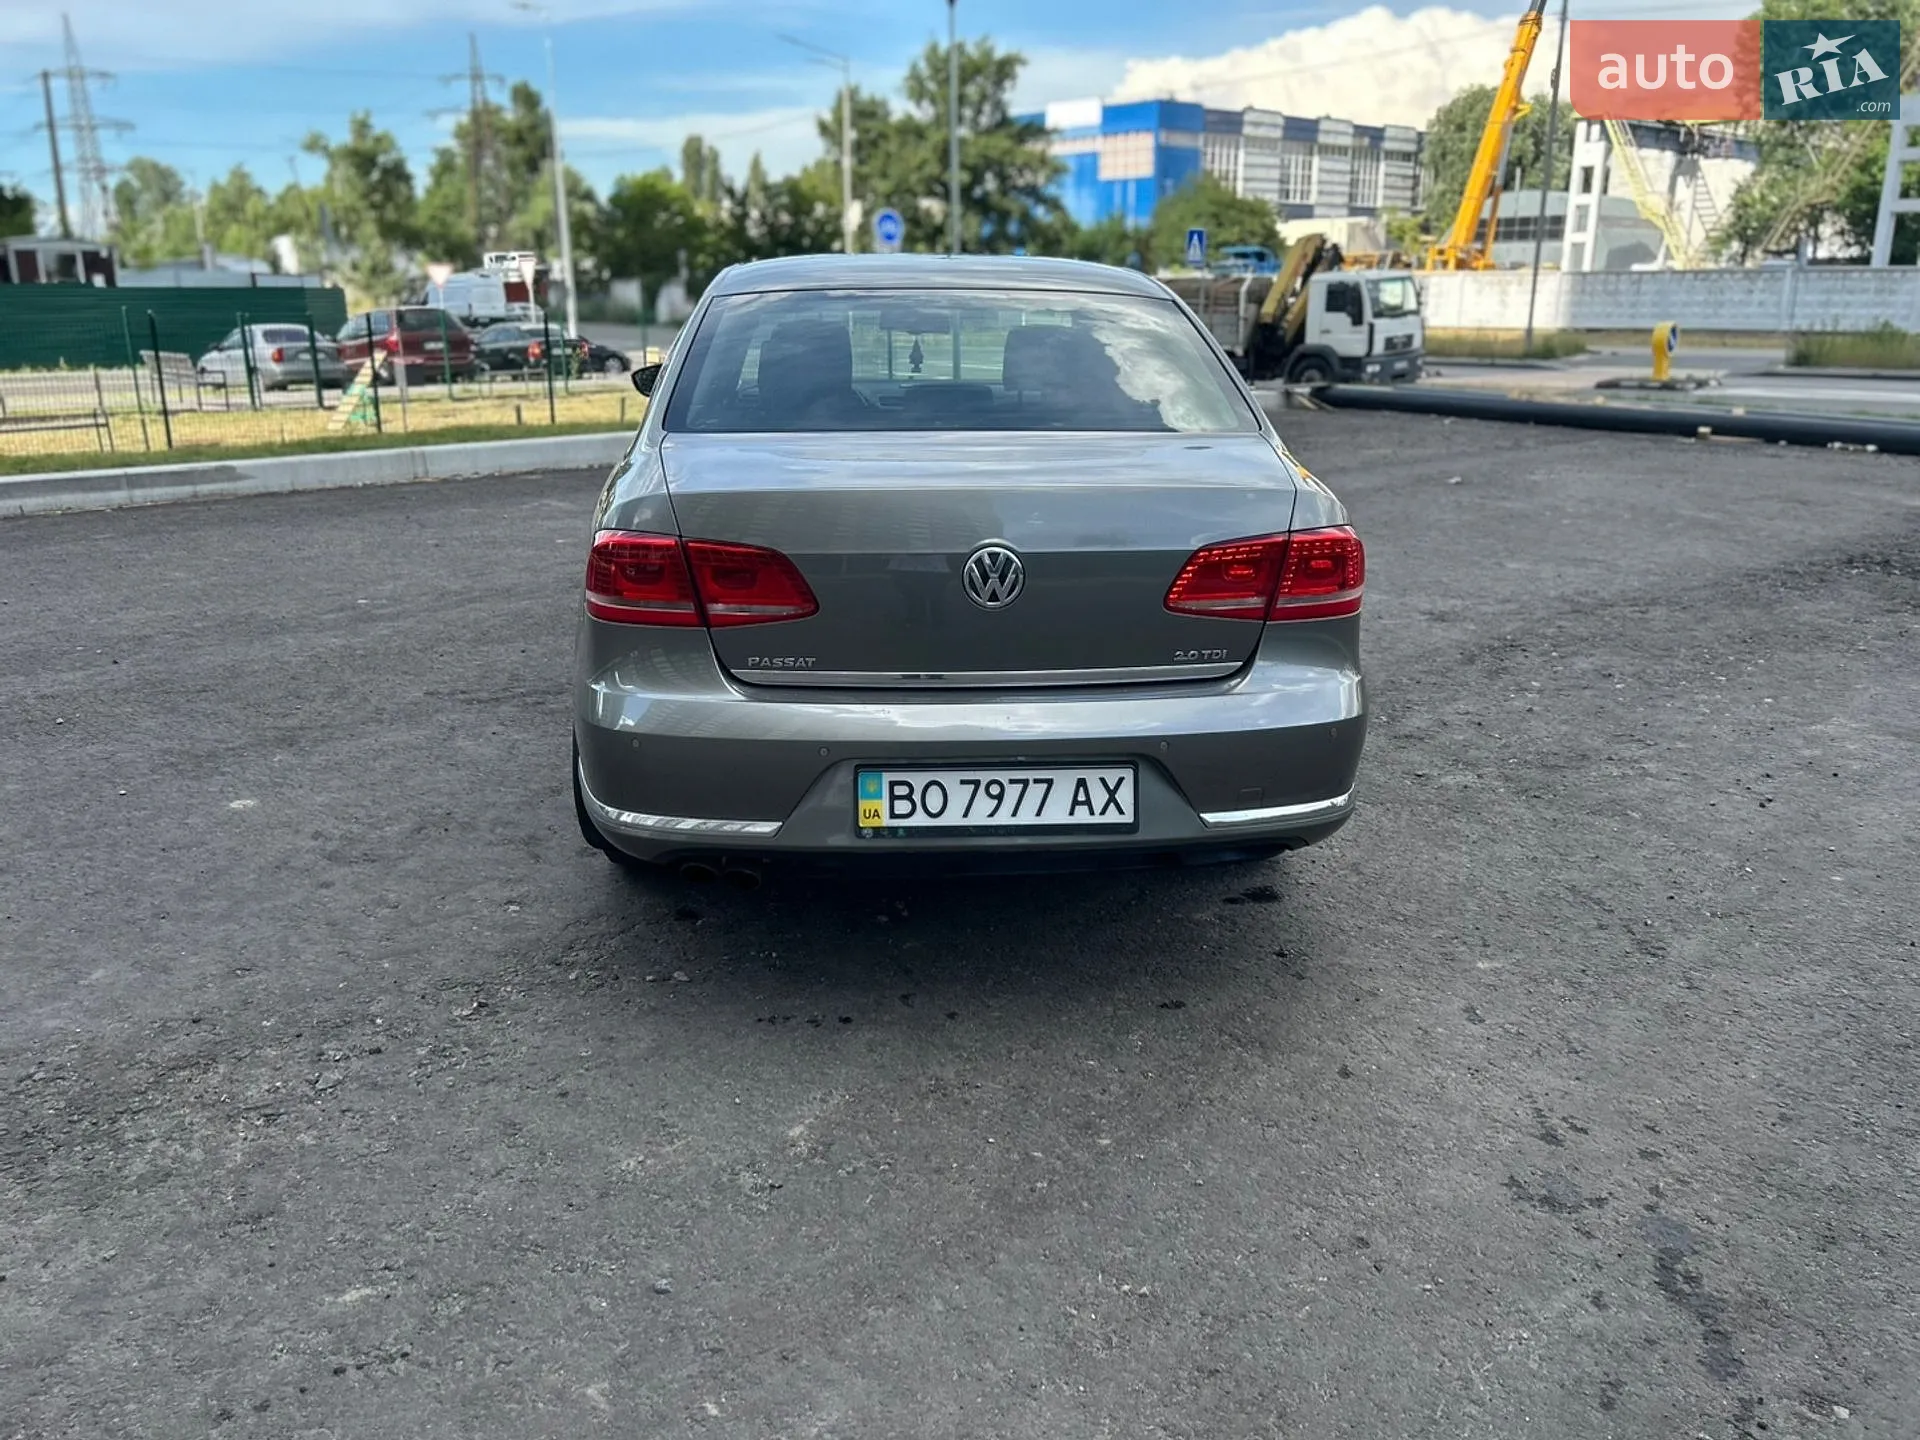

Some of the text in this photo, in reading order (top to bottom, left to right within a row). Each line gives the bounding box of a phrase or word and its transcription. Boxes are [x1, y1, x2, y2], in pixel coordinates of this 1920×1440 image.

[1201, 649, 1228, 660] TDI
[747, 656, 817, 669] PASSAT
[888, 776, 1126, 820] BO 7977 AX
[862, 808, 881, 820] UA
